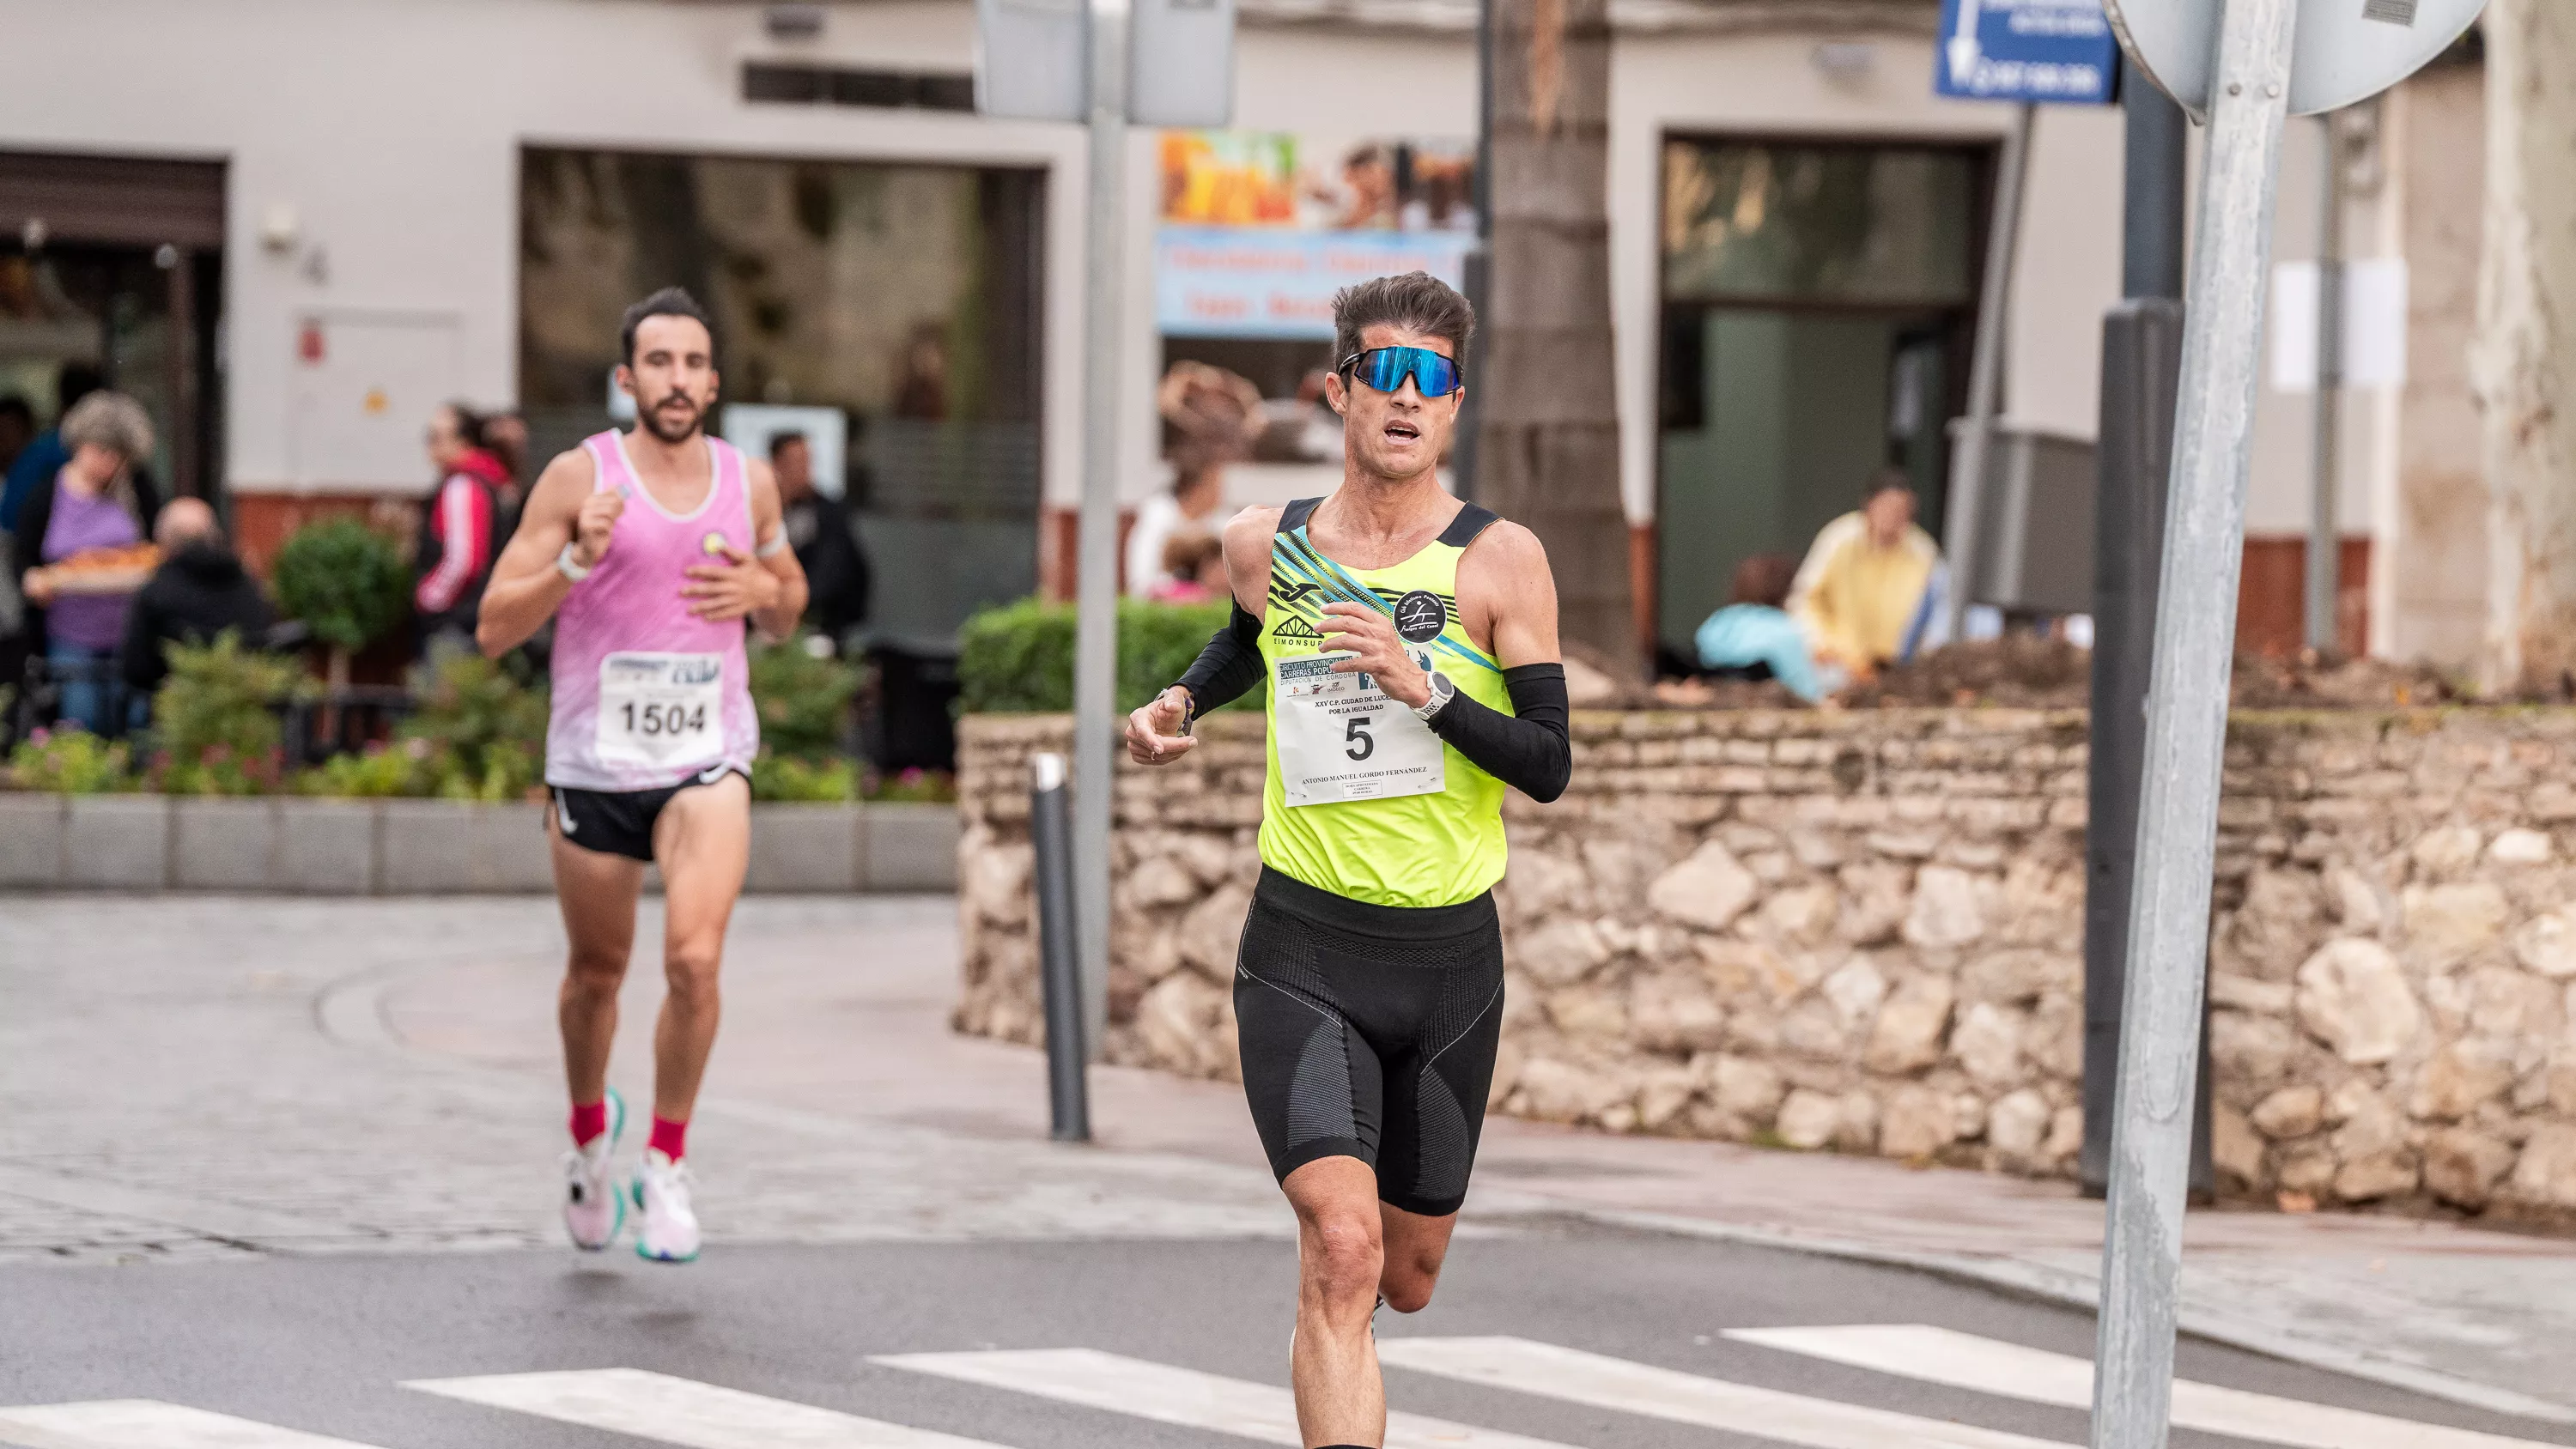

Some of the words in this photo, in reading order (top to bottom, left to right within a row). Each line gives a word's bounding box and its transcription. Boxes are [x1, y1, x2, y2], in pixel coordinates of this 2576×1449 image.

[1279, 662, 1306, 671] CIRCUITO
[1280, 668, 1312, 679] CARRERAS
[1313, 665, 1333, 676] POPU
[1280, 676, 1312, 686] DIPUTACIÓN
[1326, 672, 1357, 681] CÓRDOBA
[1352, 704, 1384, 712] IGUALDAD
[621, 700, 705, 736] 1504
[1346, 717, 1374, 761] 5
[1302, 776, 1329, 785] ANTONIO
[1358, 770, 1385, 779] GORDO
[1386, 766, 1428, 776] FERNÁNDEZ
